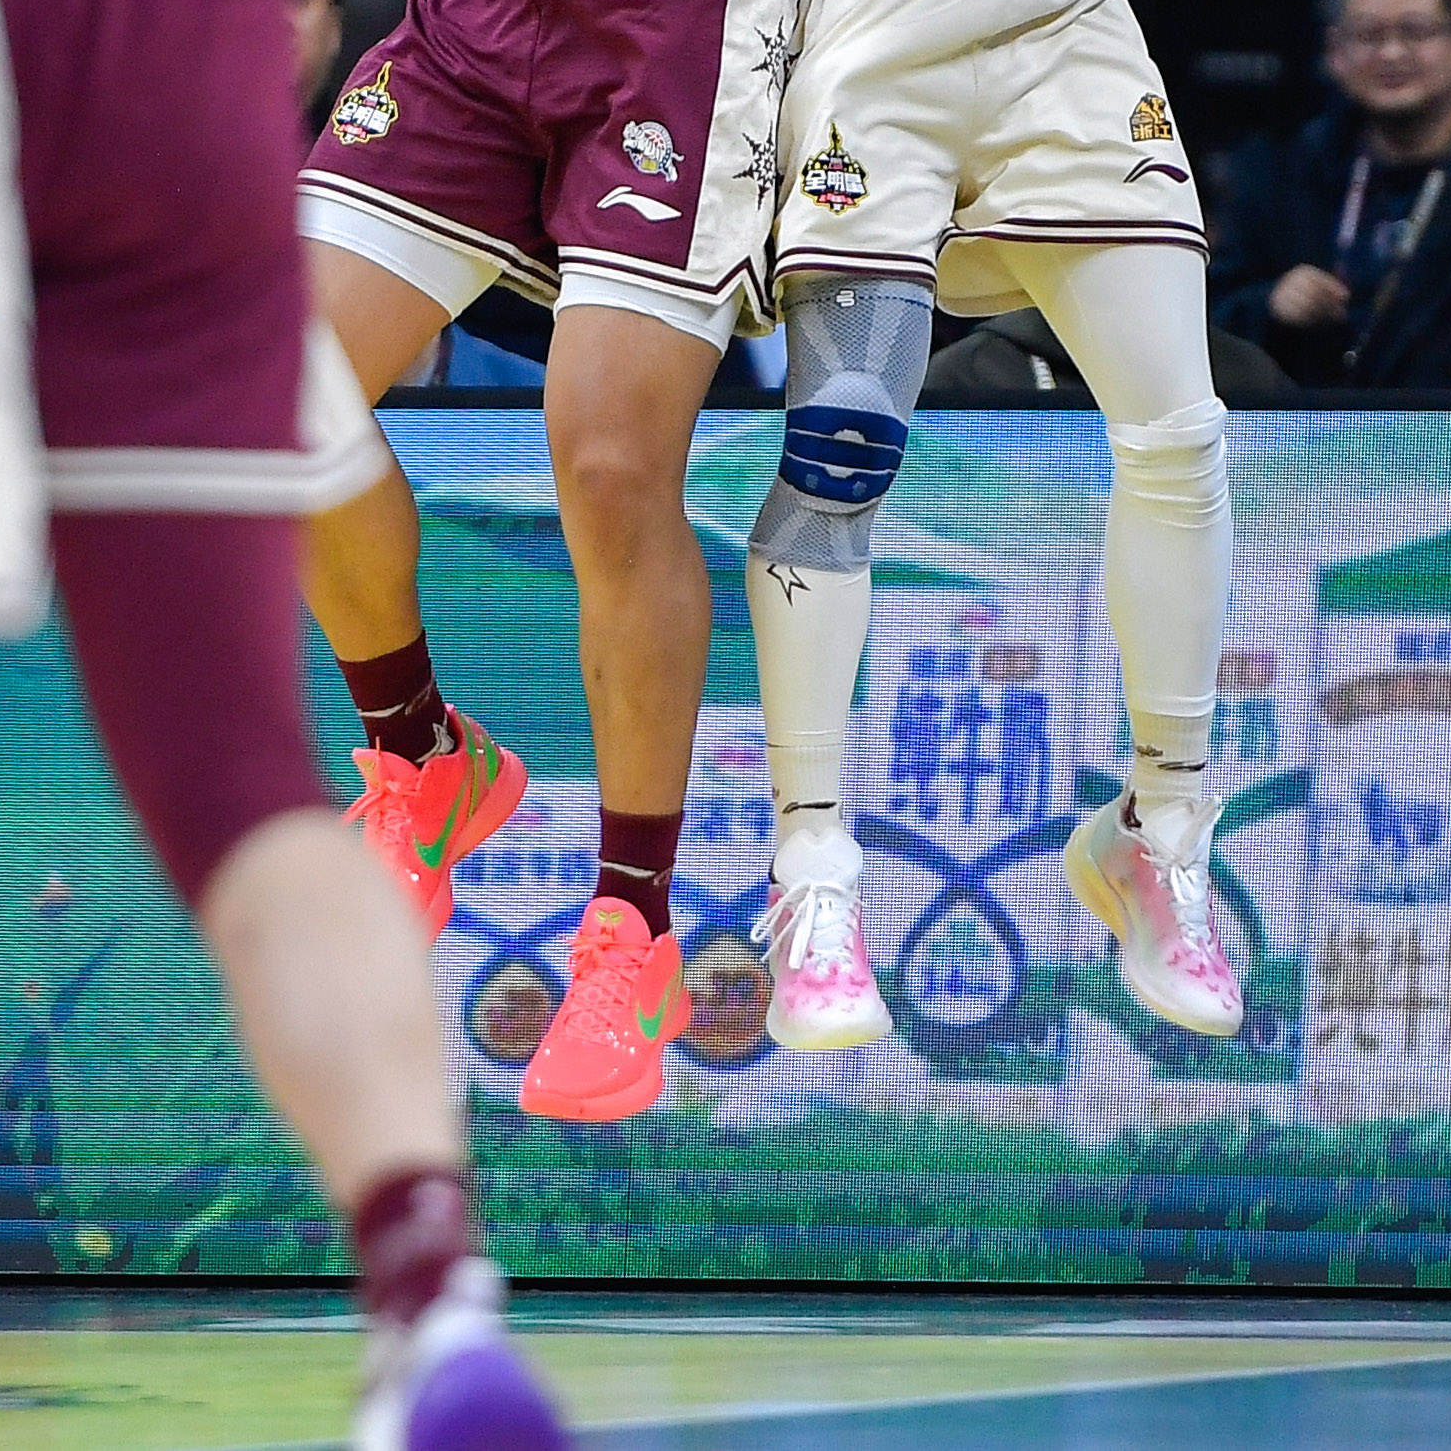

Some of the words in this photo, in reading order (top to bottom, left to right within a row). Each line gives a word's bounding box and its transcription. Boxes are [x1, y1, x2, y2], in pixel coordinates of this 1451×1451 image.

[804, 170, 866, 194] 全明星
[888, 684, 1050, 825] 纯牛奶
